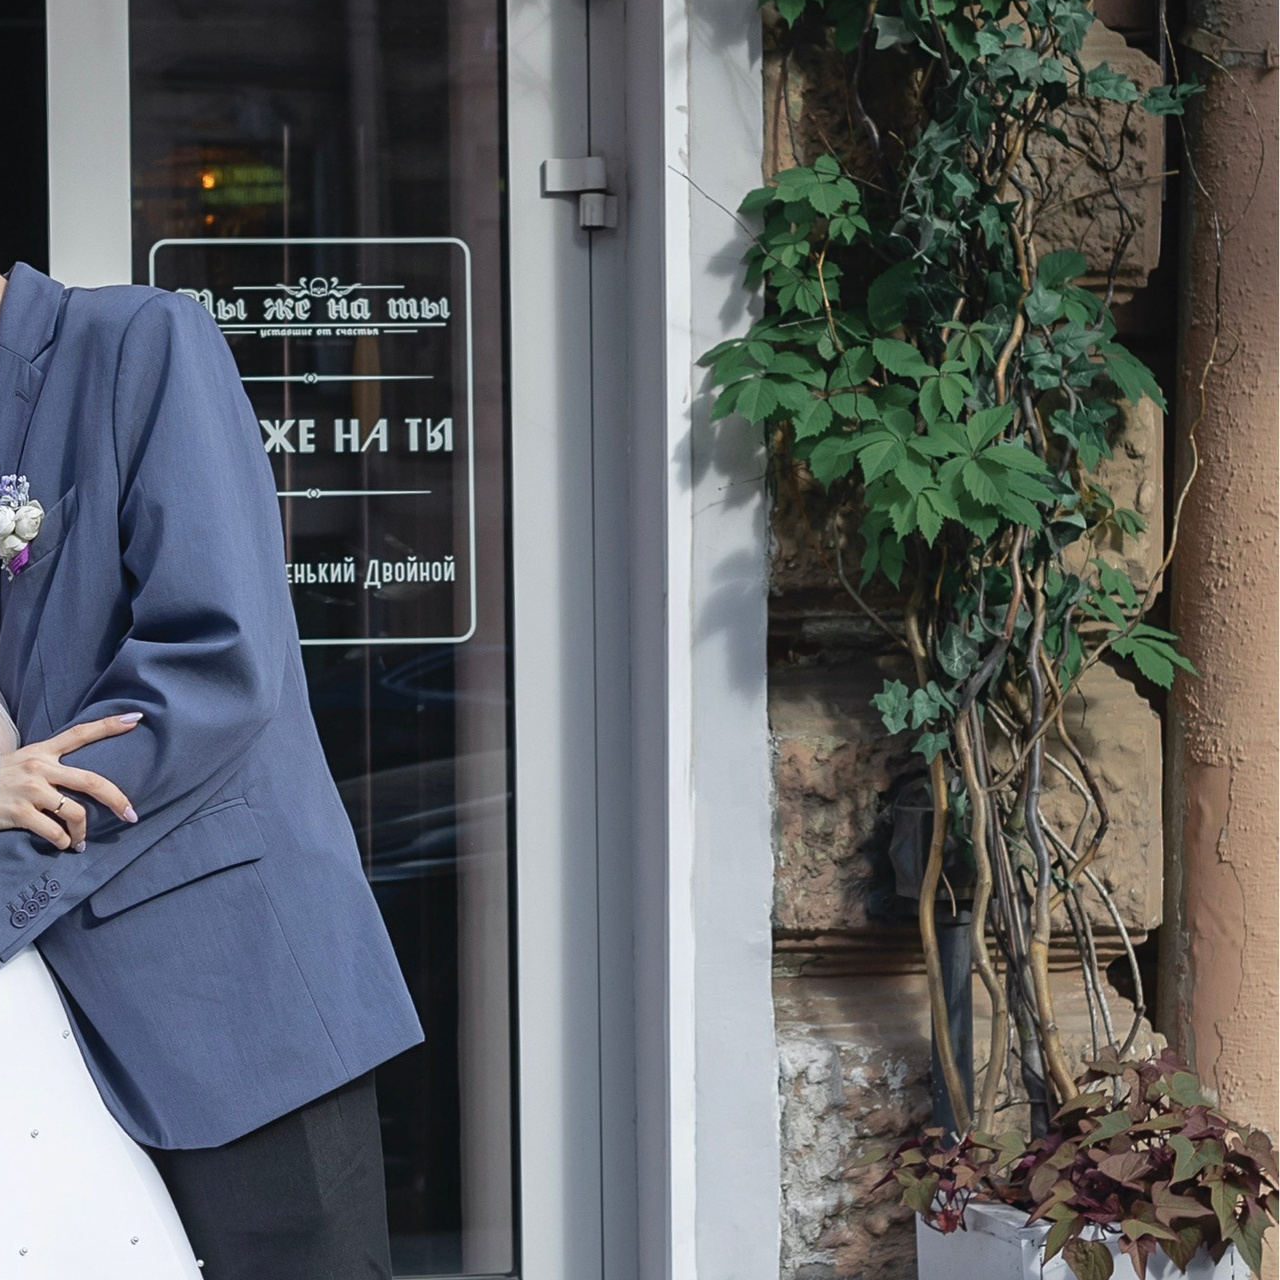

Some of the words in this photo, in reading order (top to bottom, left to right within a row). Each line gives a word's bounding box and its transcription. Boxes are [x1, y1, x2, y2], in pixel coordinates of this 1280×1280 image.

[263, 296, 311, 320] же
[327, 296, 371, 320] на
[387, 296, 451, 320] ты
[260, 328, 313, 338] уставшие
[316, 328, 332, 336] от
[335, 327, 379, 336] счастья
[259, 418, 316, 454] ЖЕ
[333, 417, 389, 453] НА
[405, 417, 454, 452] ТЫ
[285, 556, 356, 584] енький
